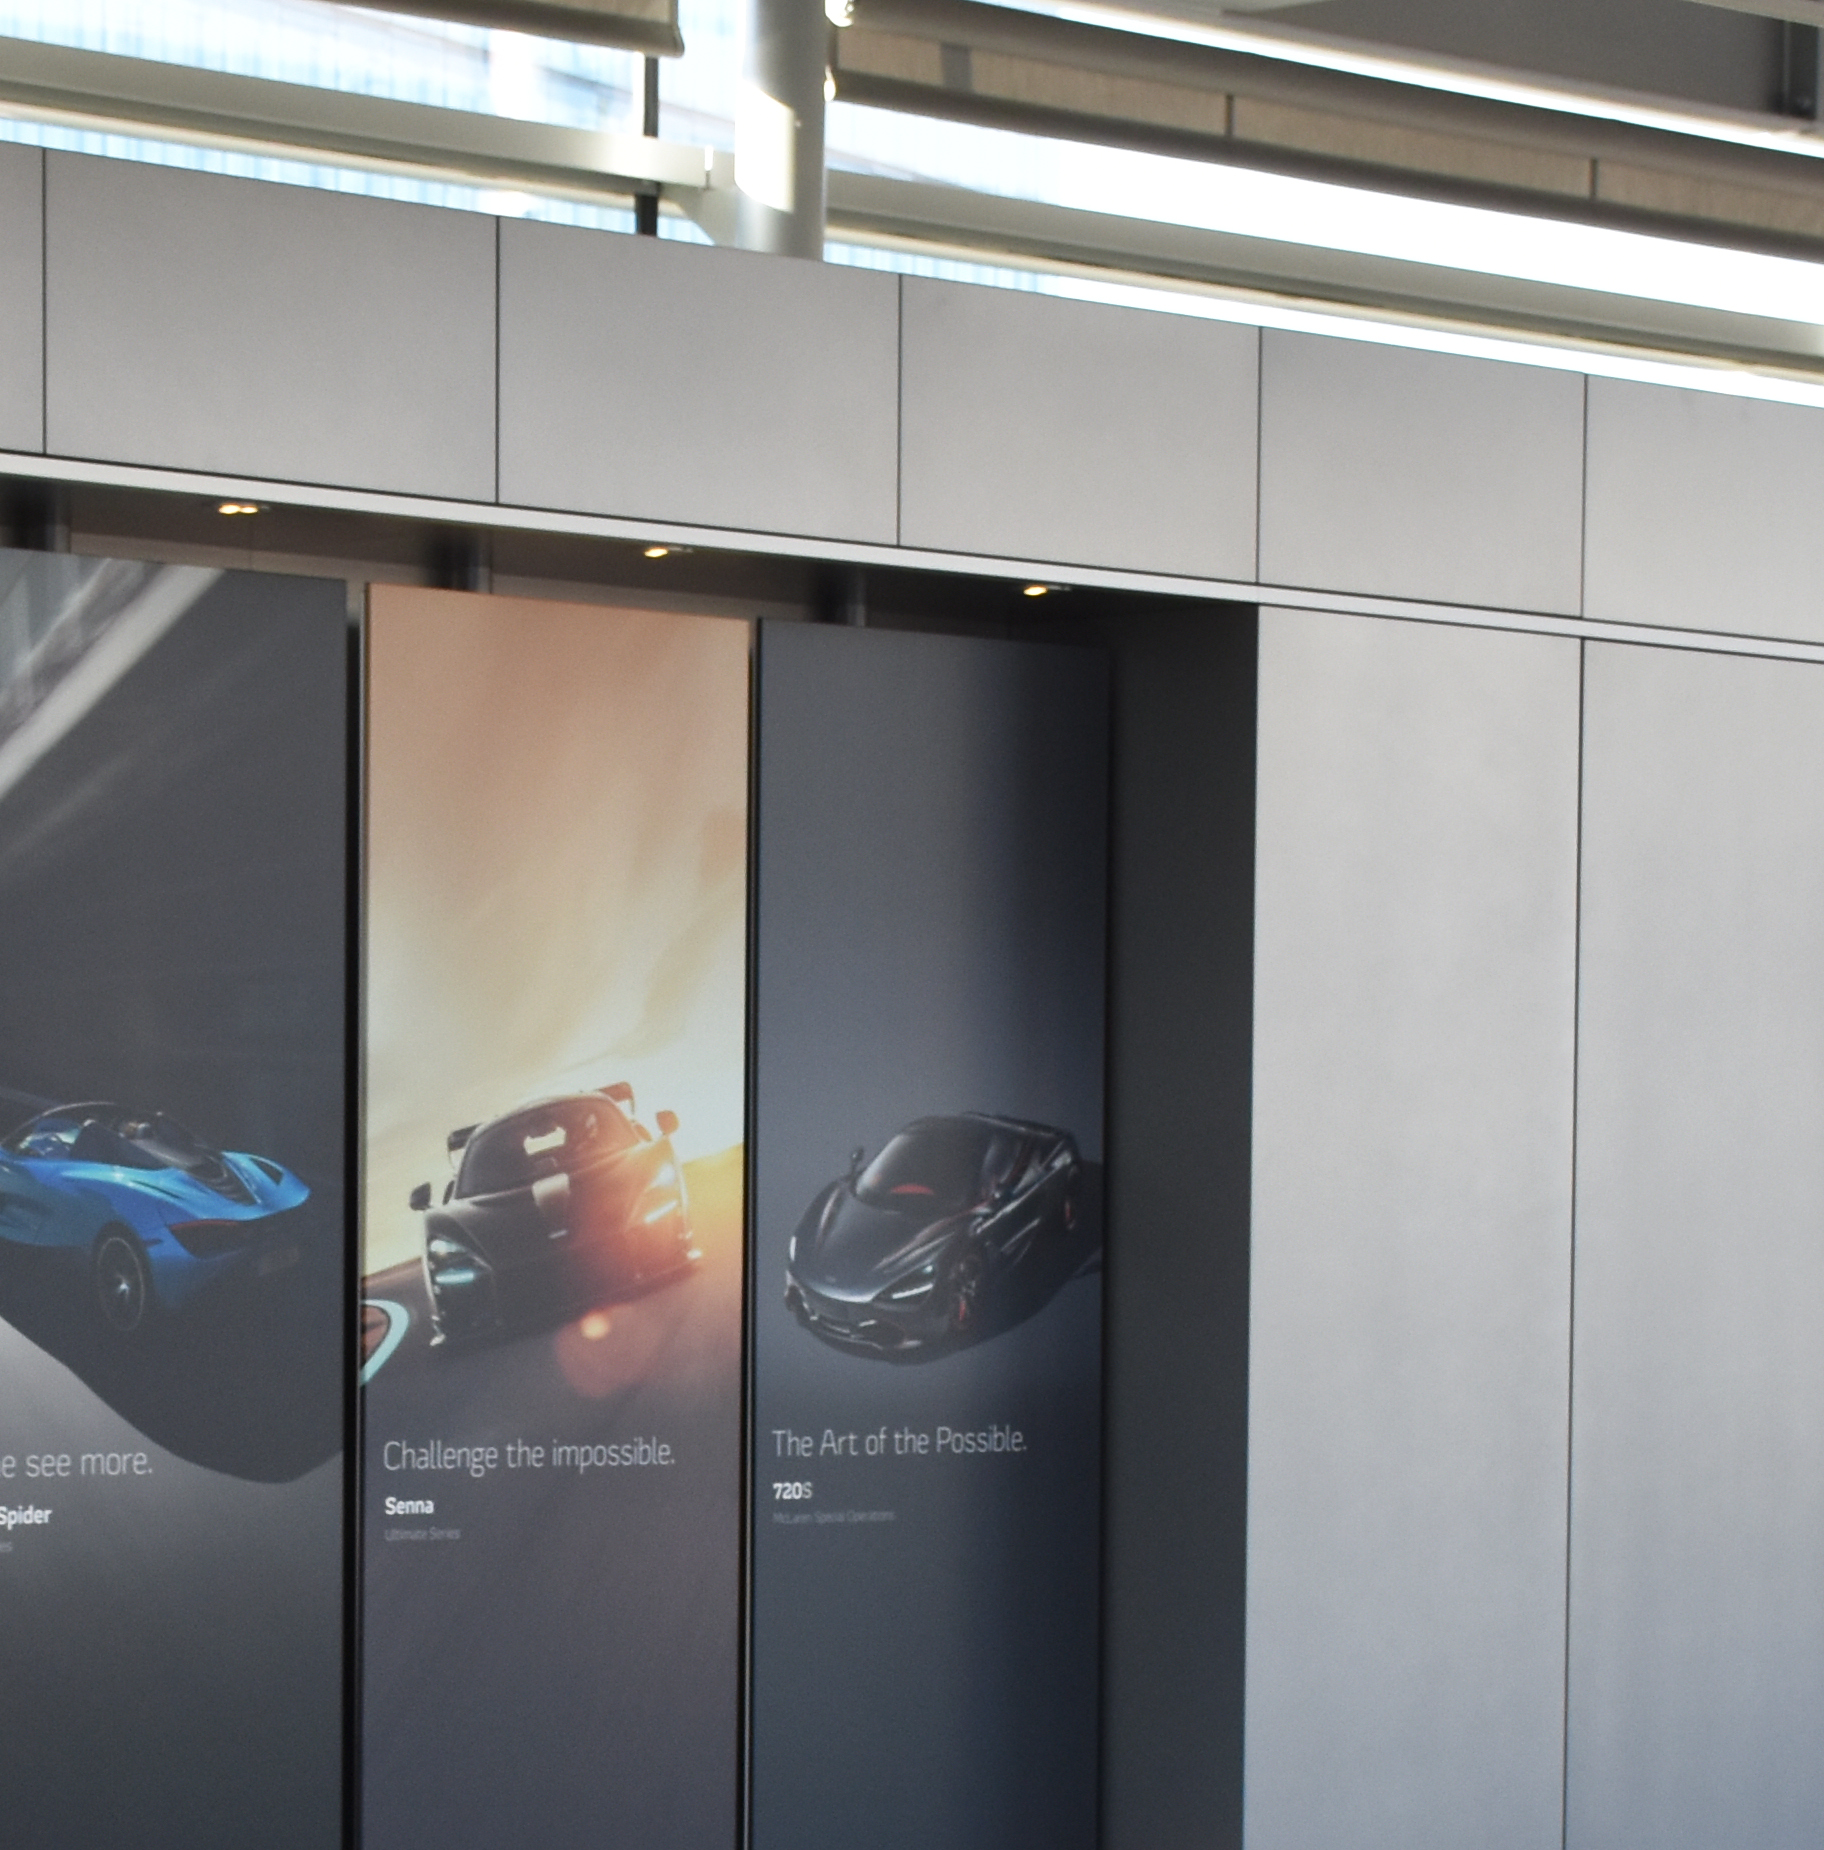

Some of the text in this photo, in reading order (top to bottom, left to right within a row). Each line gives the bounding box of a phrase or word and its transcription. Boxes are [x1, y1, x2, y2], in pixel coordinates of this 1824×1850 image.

[771, 1425, 1028, 1457] The Art of the Possible.
[25, 1453, 71, 1478] see
[81, 1452, 154, 1476] more.
[383, 1436, 676, 1478] Challenge the impossible.
[772, 1482, 813, 1500] 720S
[384, 1496, 435, 1516] Senna
[429, 1526, 461, 1540] Series
